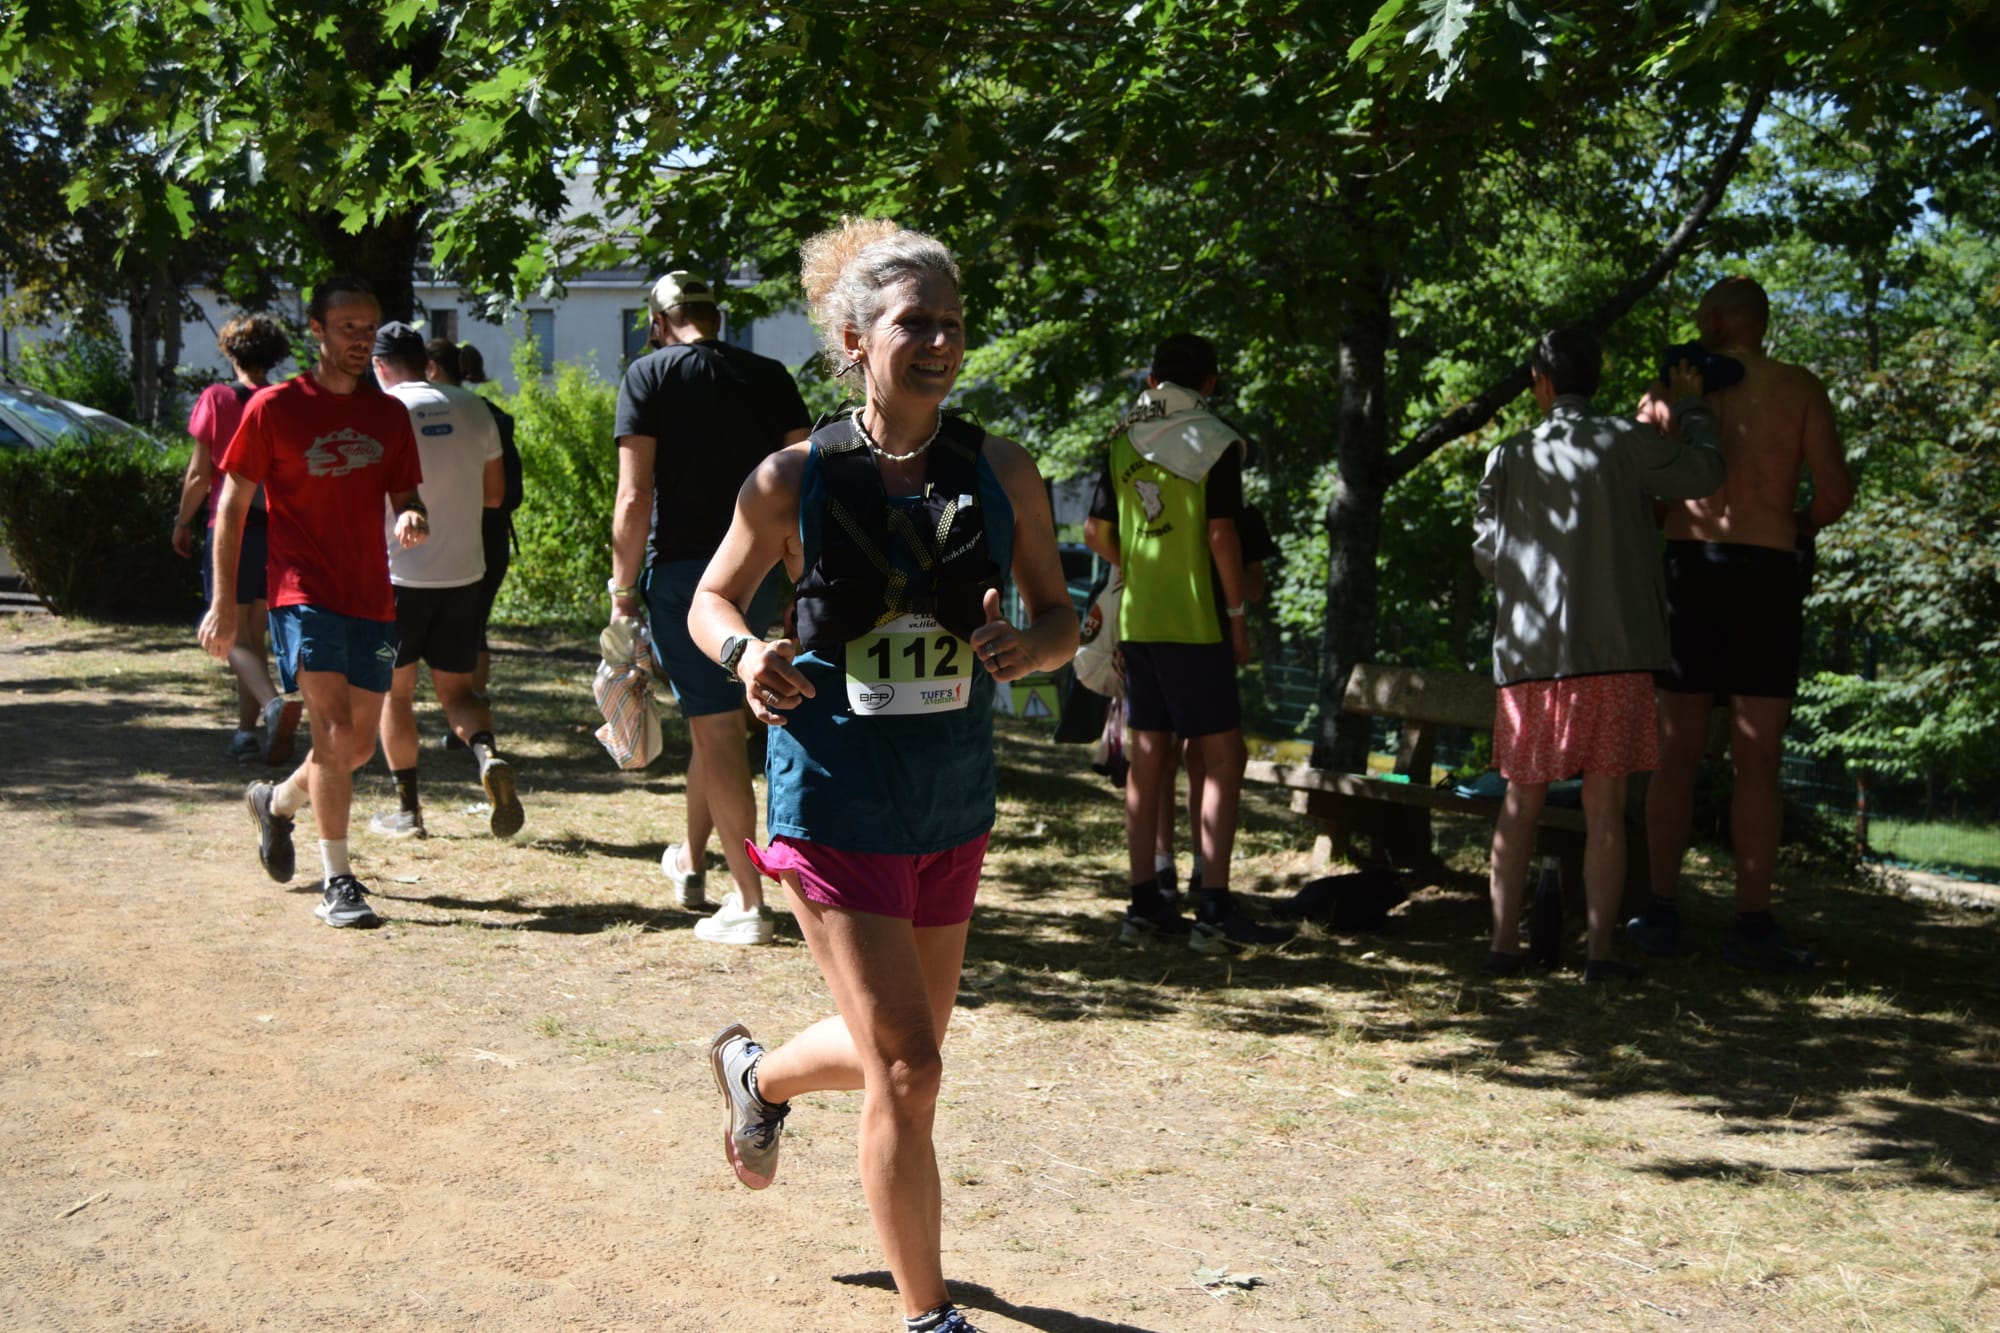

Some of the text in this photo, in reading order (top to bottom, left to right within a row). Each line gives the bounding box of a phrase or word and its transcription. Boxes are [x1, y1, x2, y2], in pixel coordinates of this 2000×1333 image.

[867, 635, 959, 679] 112
[859, 693, 889, 702] BFP
[920, 688, 953, 700] TUFF'S
